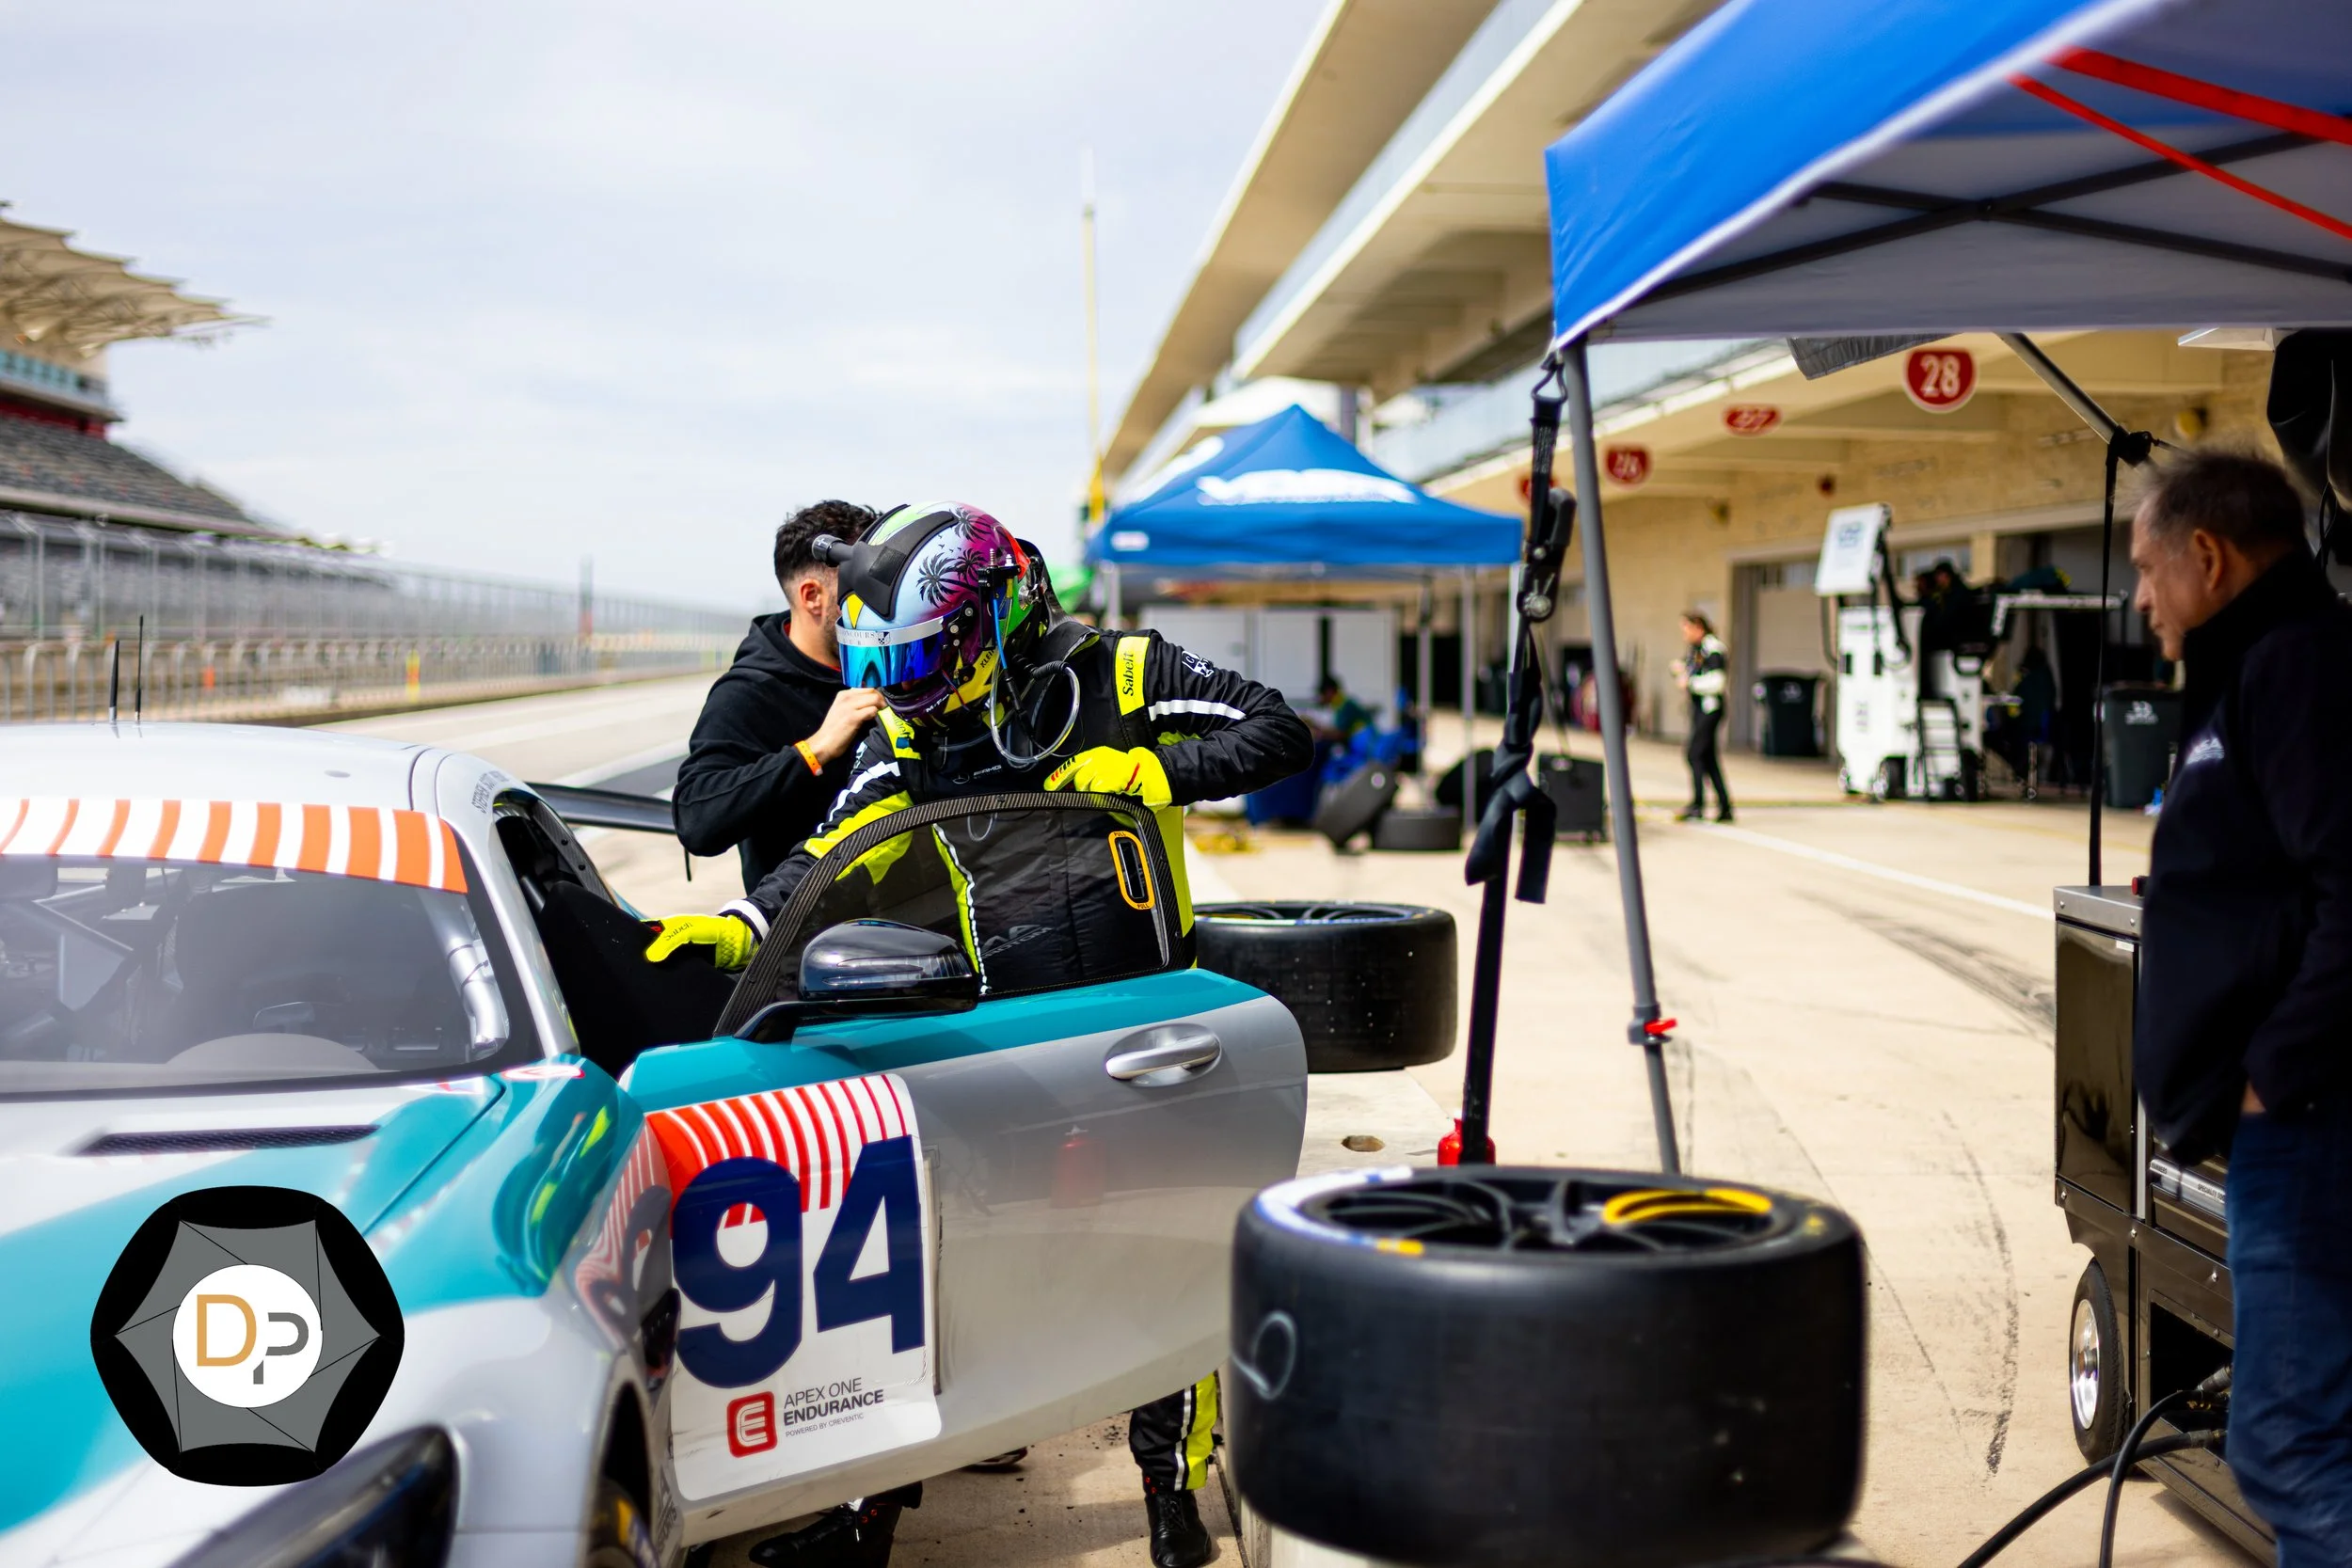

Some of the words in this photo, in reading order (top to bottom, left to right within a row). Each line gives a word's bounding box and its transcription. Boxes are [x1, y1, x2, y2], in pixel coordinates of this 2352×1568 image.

[1920, 354, 1961, 398] 28
[1122, 652, 1134, 696] Sabelt
[672, 1134, 926, 1389] 94
[784, 1386, 825, 1409] APEX
[828, 1377, 862, 1398] ONE
[784, 1389, 884, 1427] ENDURANCE
[786, 1424, 818, 1437] POWERED
[818, 1421, 828, 1430] BY
[828, 1413, 864, 1427] CREVENTIC
